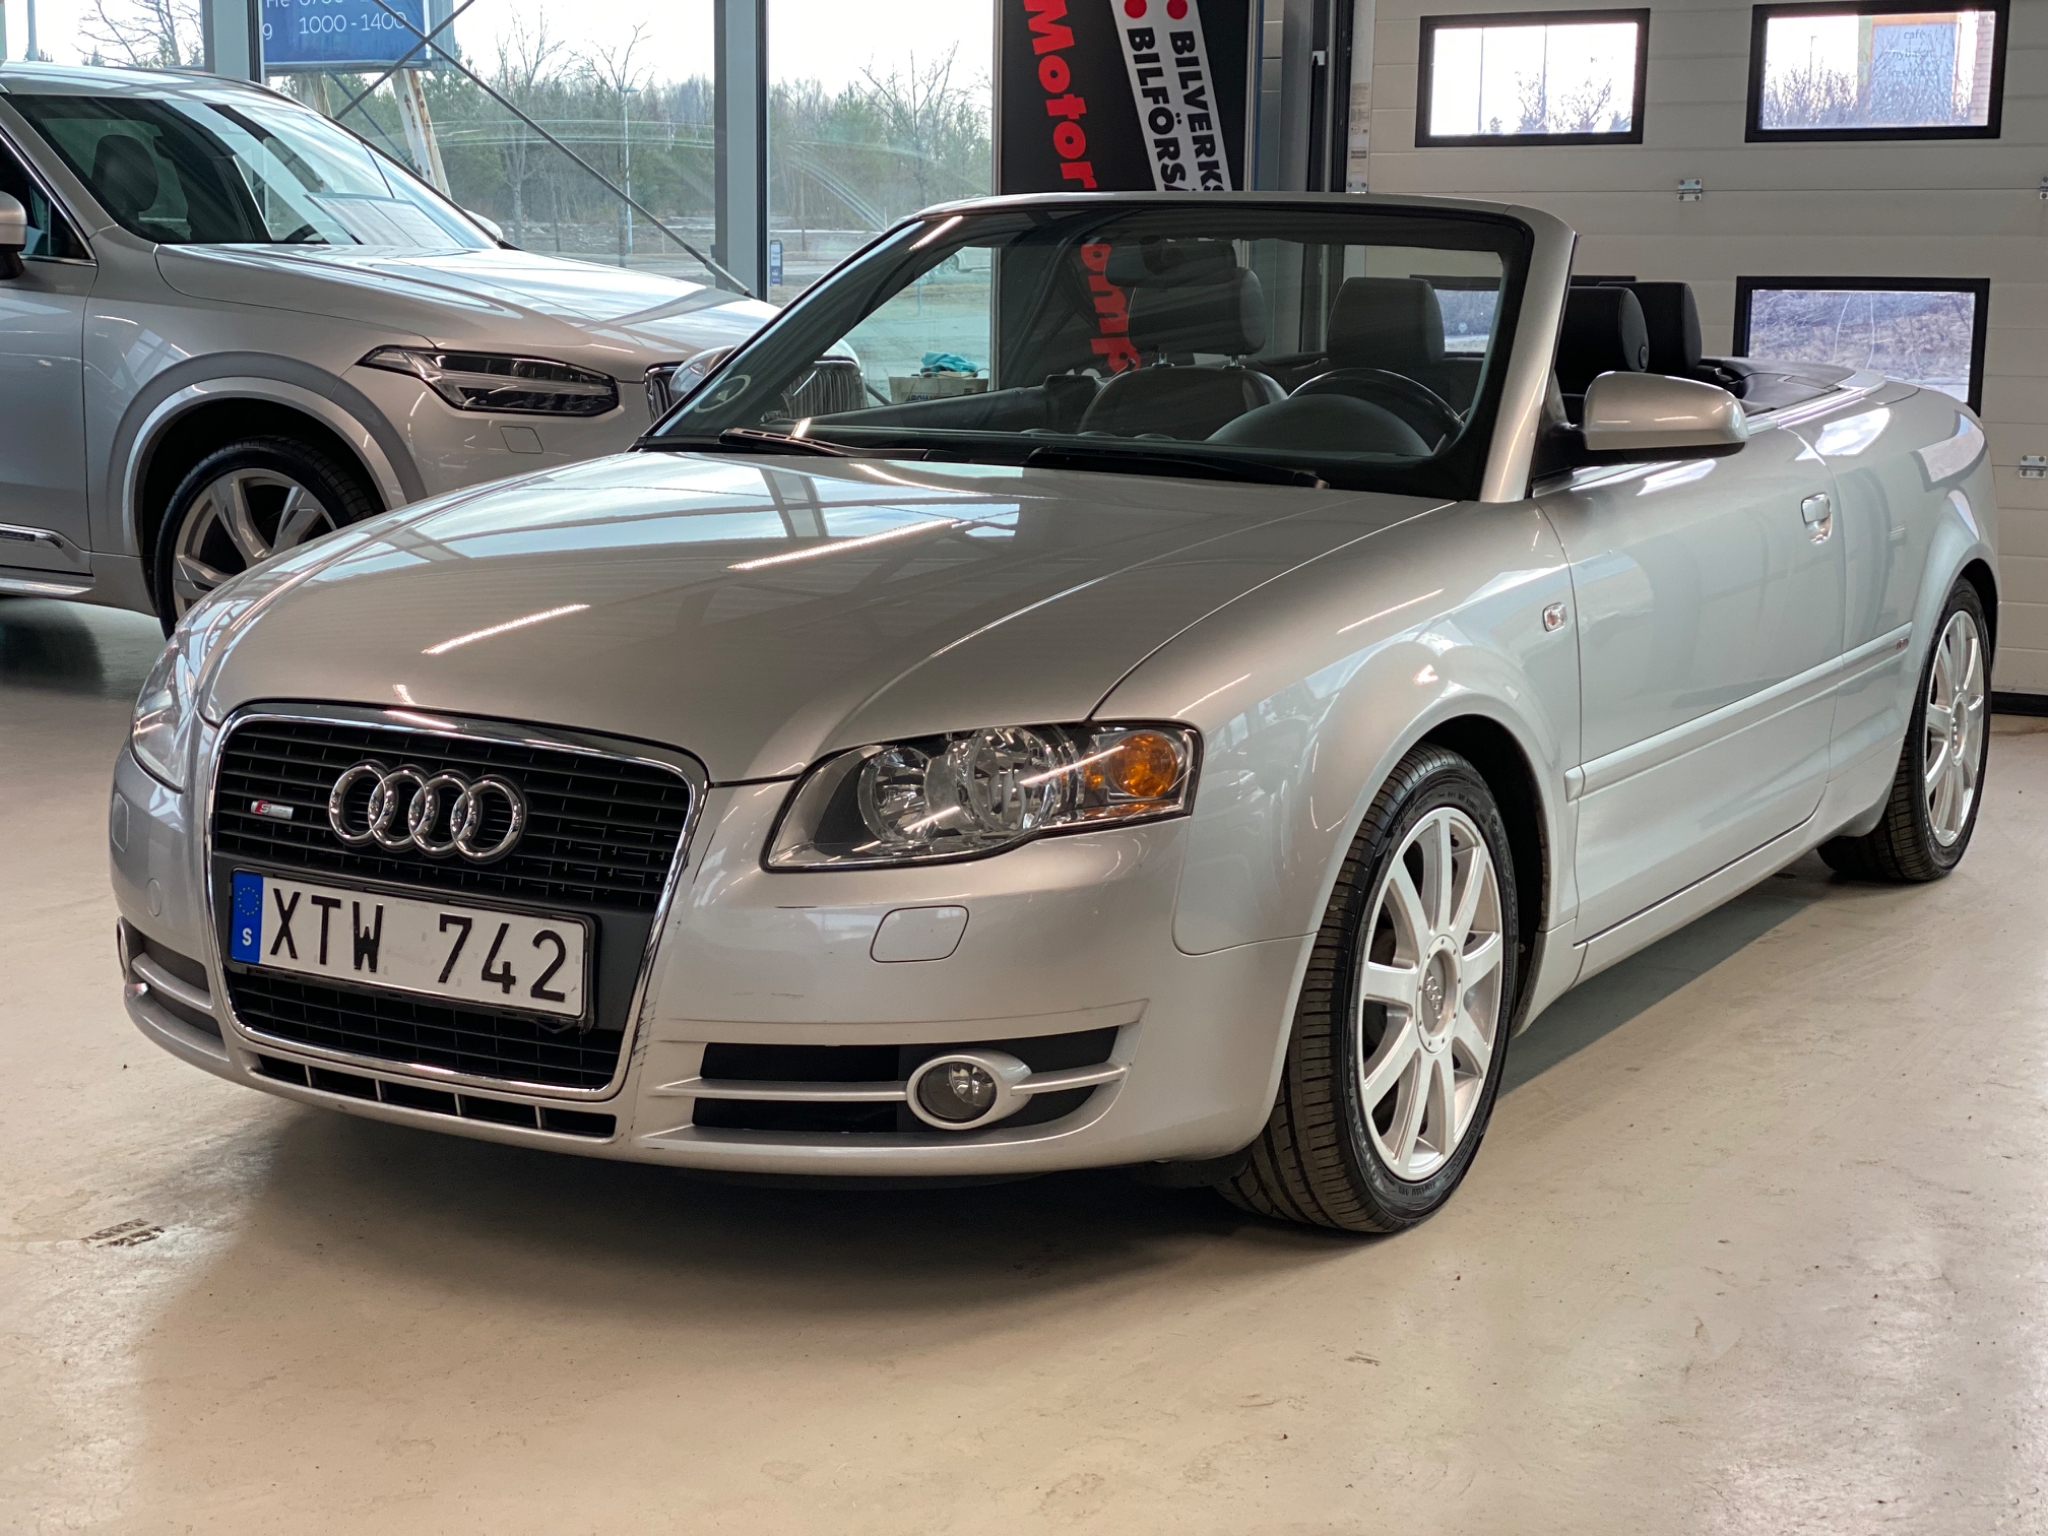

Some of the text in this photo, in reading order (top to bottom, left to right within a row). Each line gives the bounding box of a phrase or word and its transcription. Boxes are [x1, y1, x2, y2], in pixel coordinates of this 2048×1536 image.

[1126, 27, 1197, 191] BILFÖRS
[1169, 31, 1225, 191] BILVERK
[241, 928, 253, 947] S
[270, 888, 567, 1003] XTW 742
